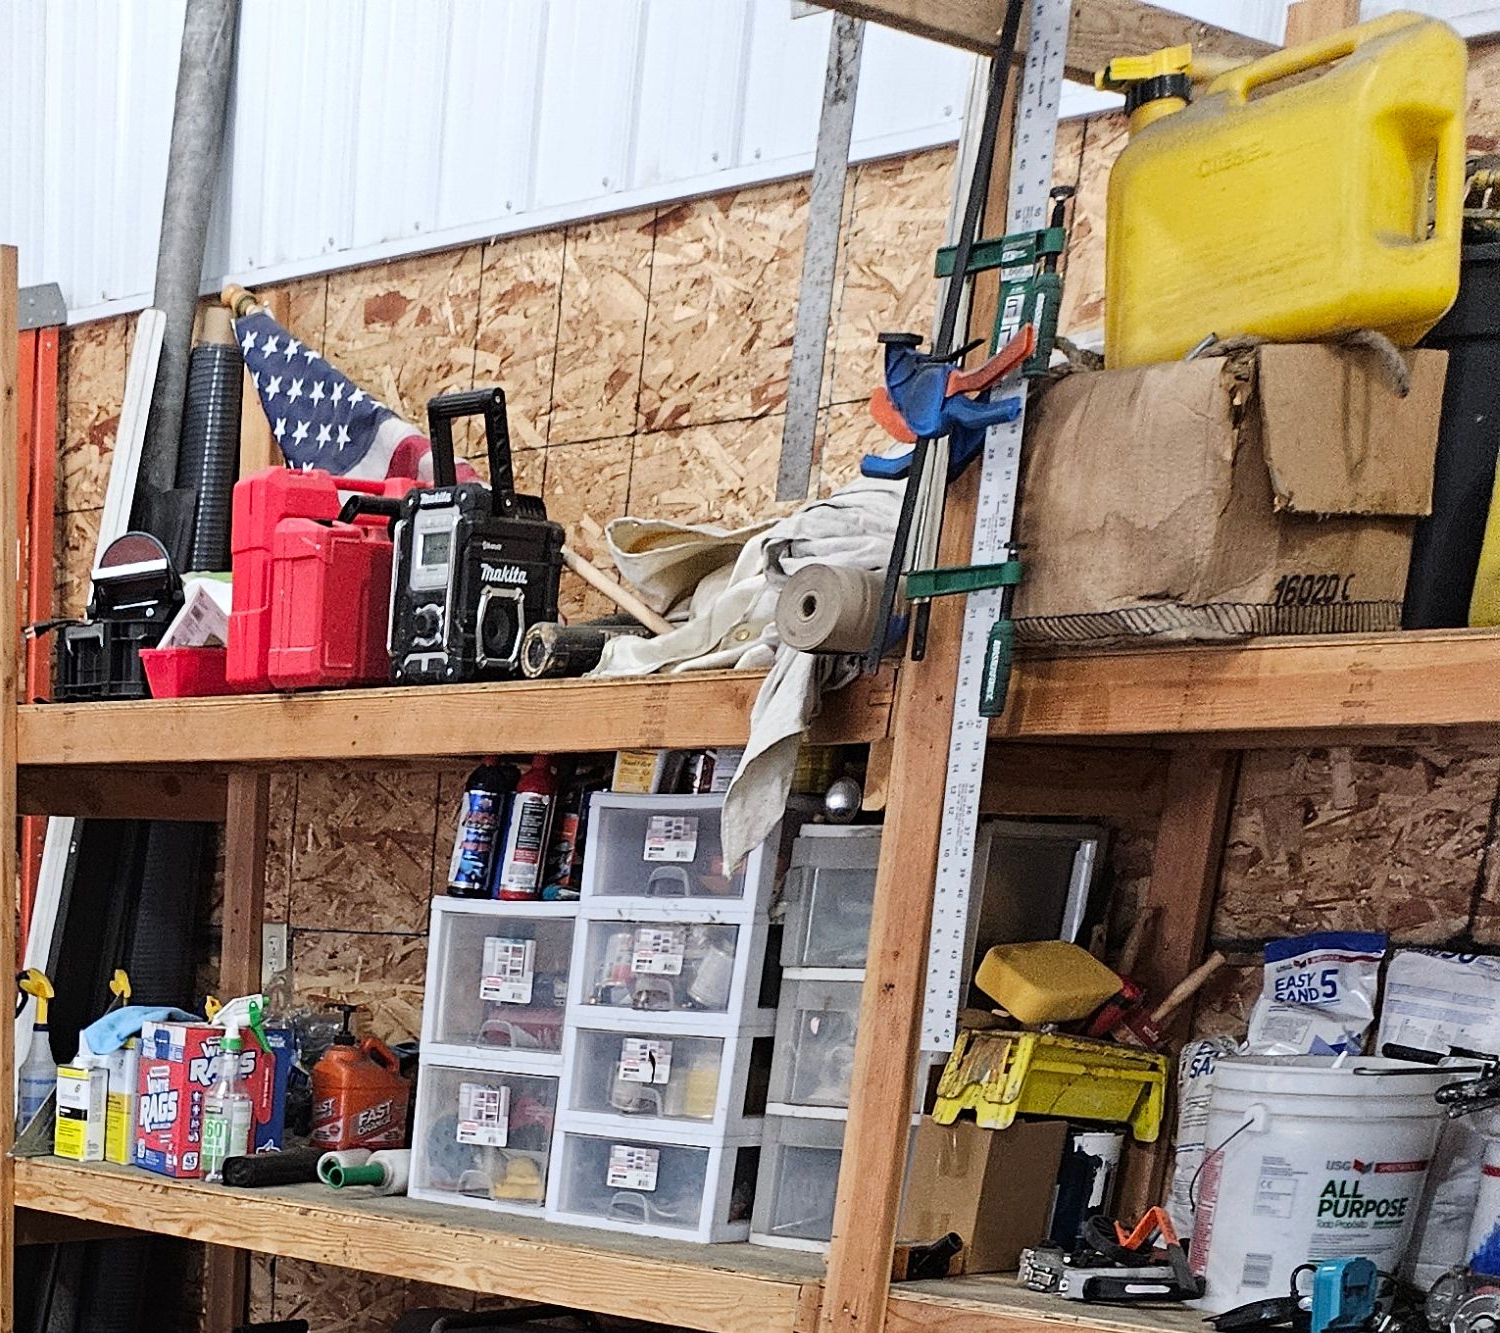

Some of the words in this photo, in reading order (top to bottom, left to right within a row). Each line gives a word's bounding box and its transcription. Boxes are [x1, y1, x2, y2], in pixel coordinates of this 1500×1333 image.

[1275, 972, 1316, 992] EASY
[1321, 969, 1339, 998] 5
[1275, 988, 1319, 1004] SAND
[140, 1091, 179, 1133] RAGS
[359, 1100, 393, 1128] FAST
[1326, 1161, 1352, 1171] USG
[1320, 1180, 1363, 1198] ALL
[1317, 1198, 1409, 1218] PURPOSE
